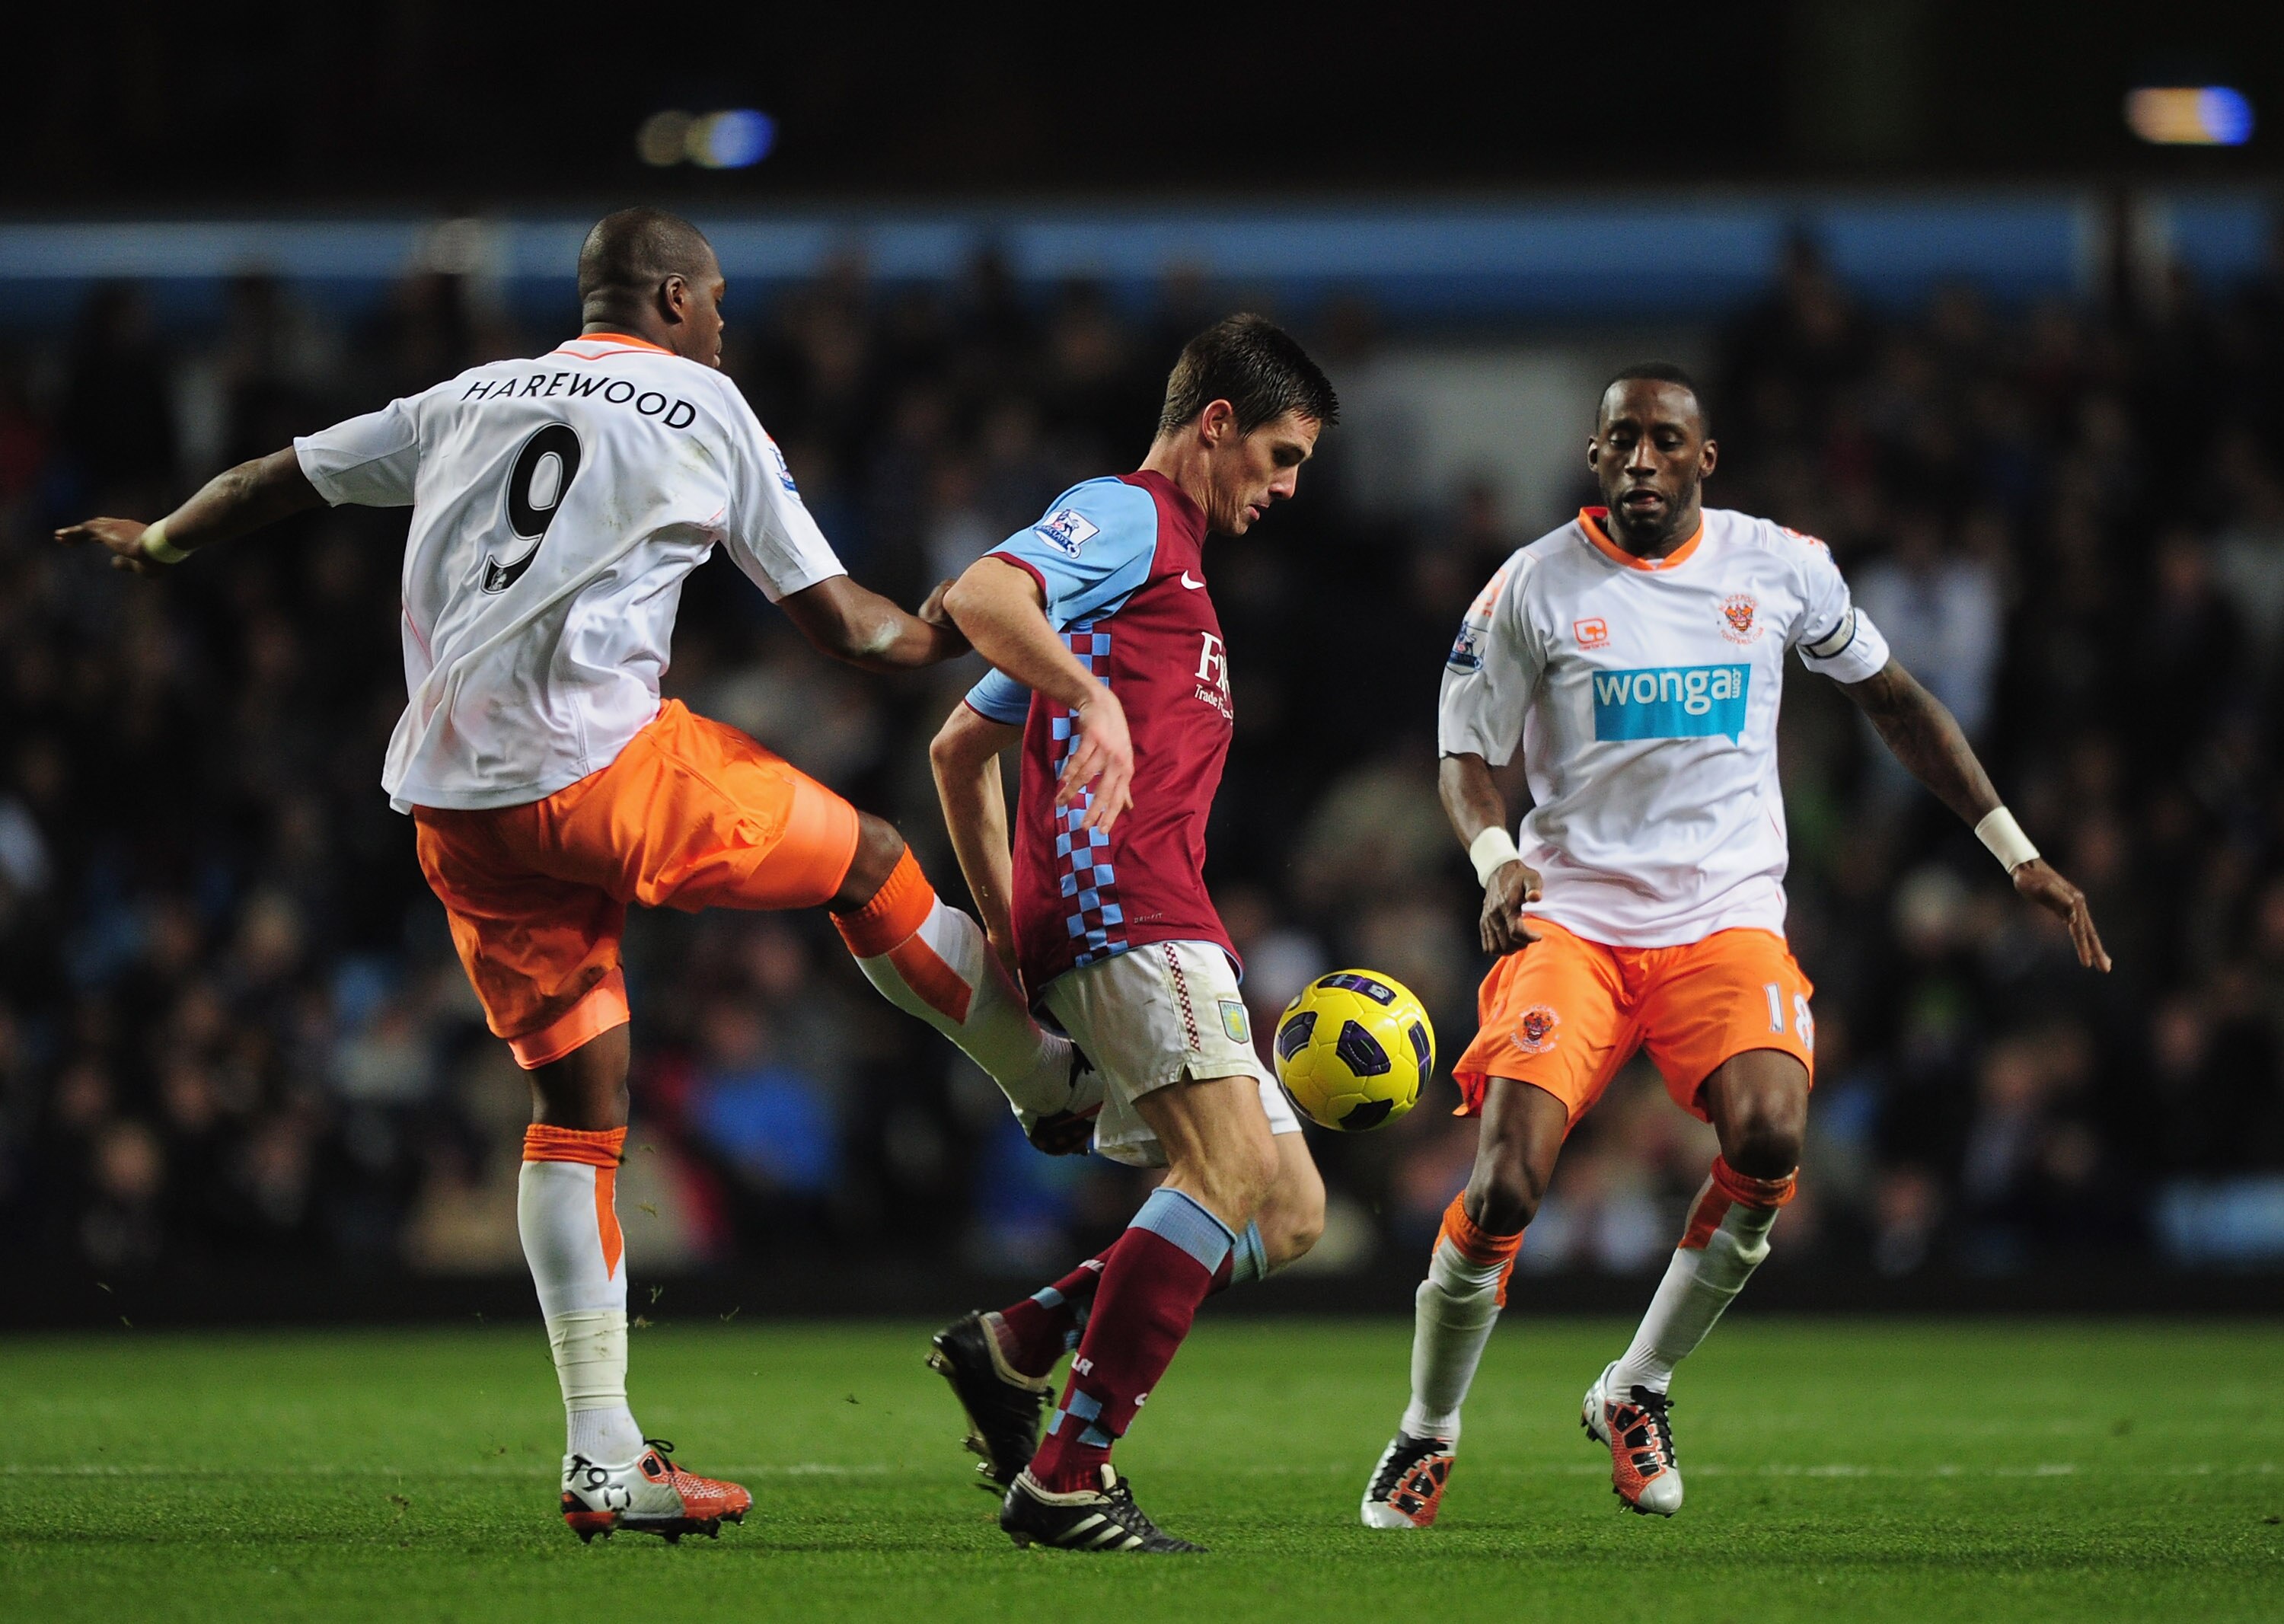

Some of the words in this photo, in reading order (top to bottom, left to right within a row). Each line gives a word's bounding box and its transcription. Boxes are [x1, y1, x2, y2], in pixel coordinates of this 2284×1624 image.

[460, 372, 697, 429] HAREWOOD
[480, 421, 585, 595] 9
[1195, 684, 1218, 707] Trade
[1595, 668, 1732, 716] wonga
[1762, 981, 1814, 1052] 18
